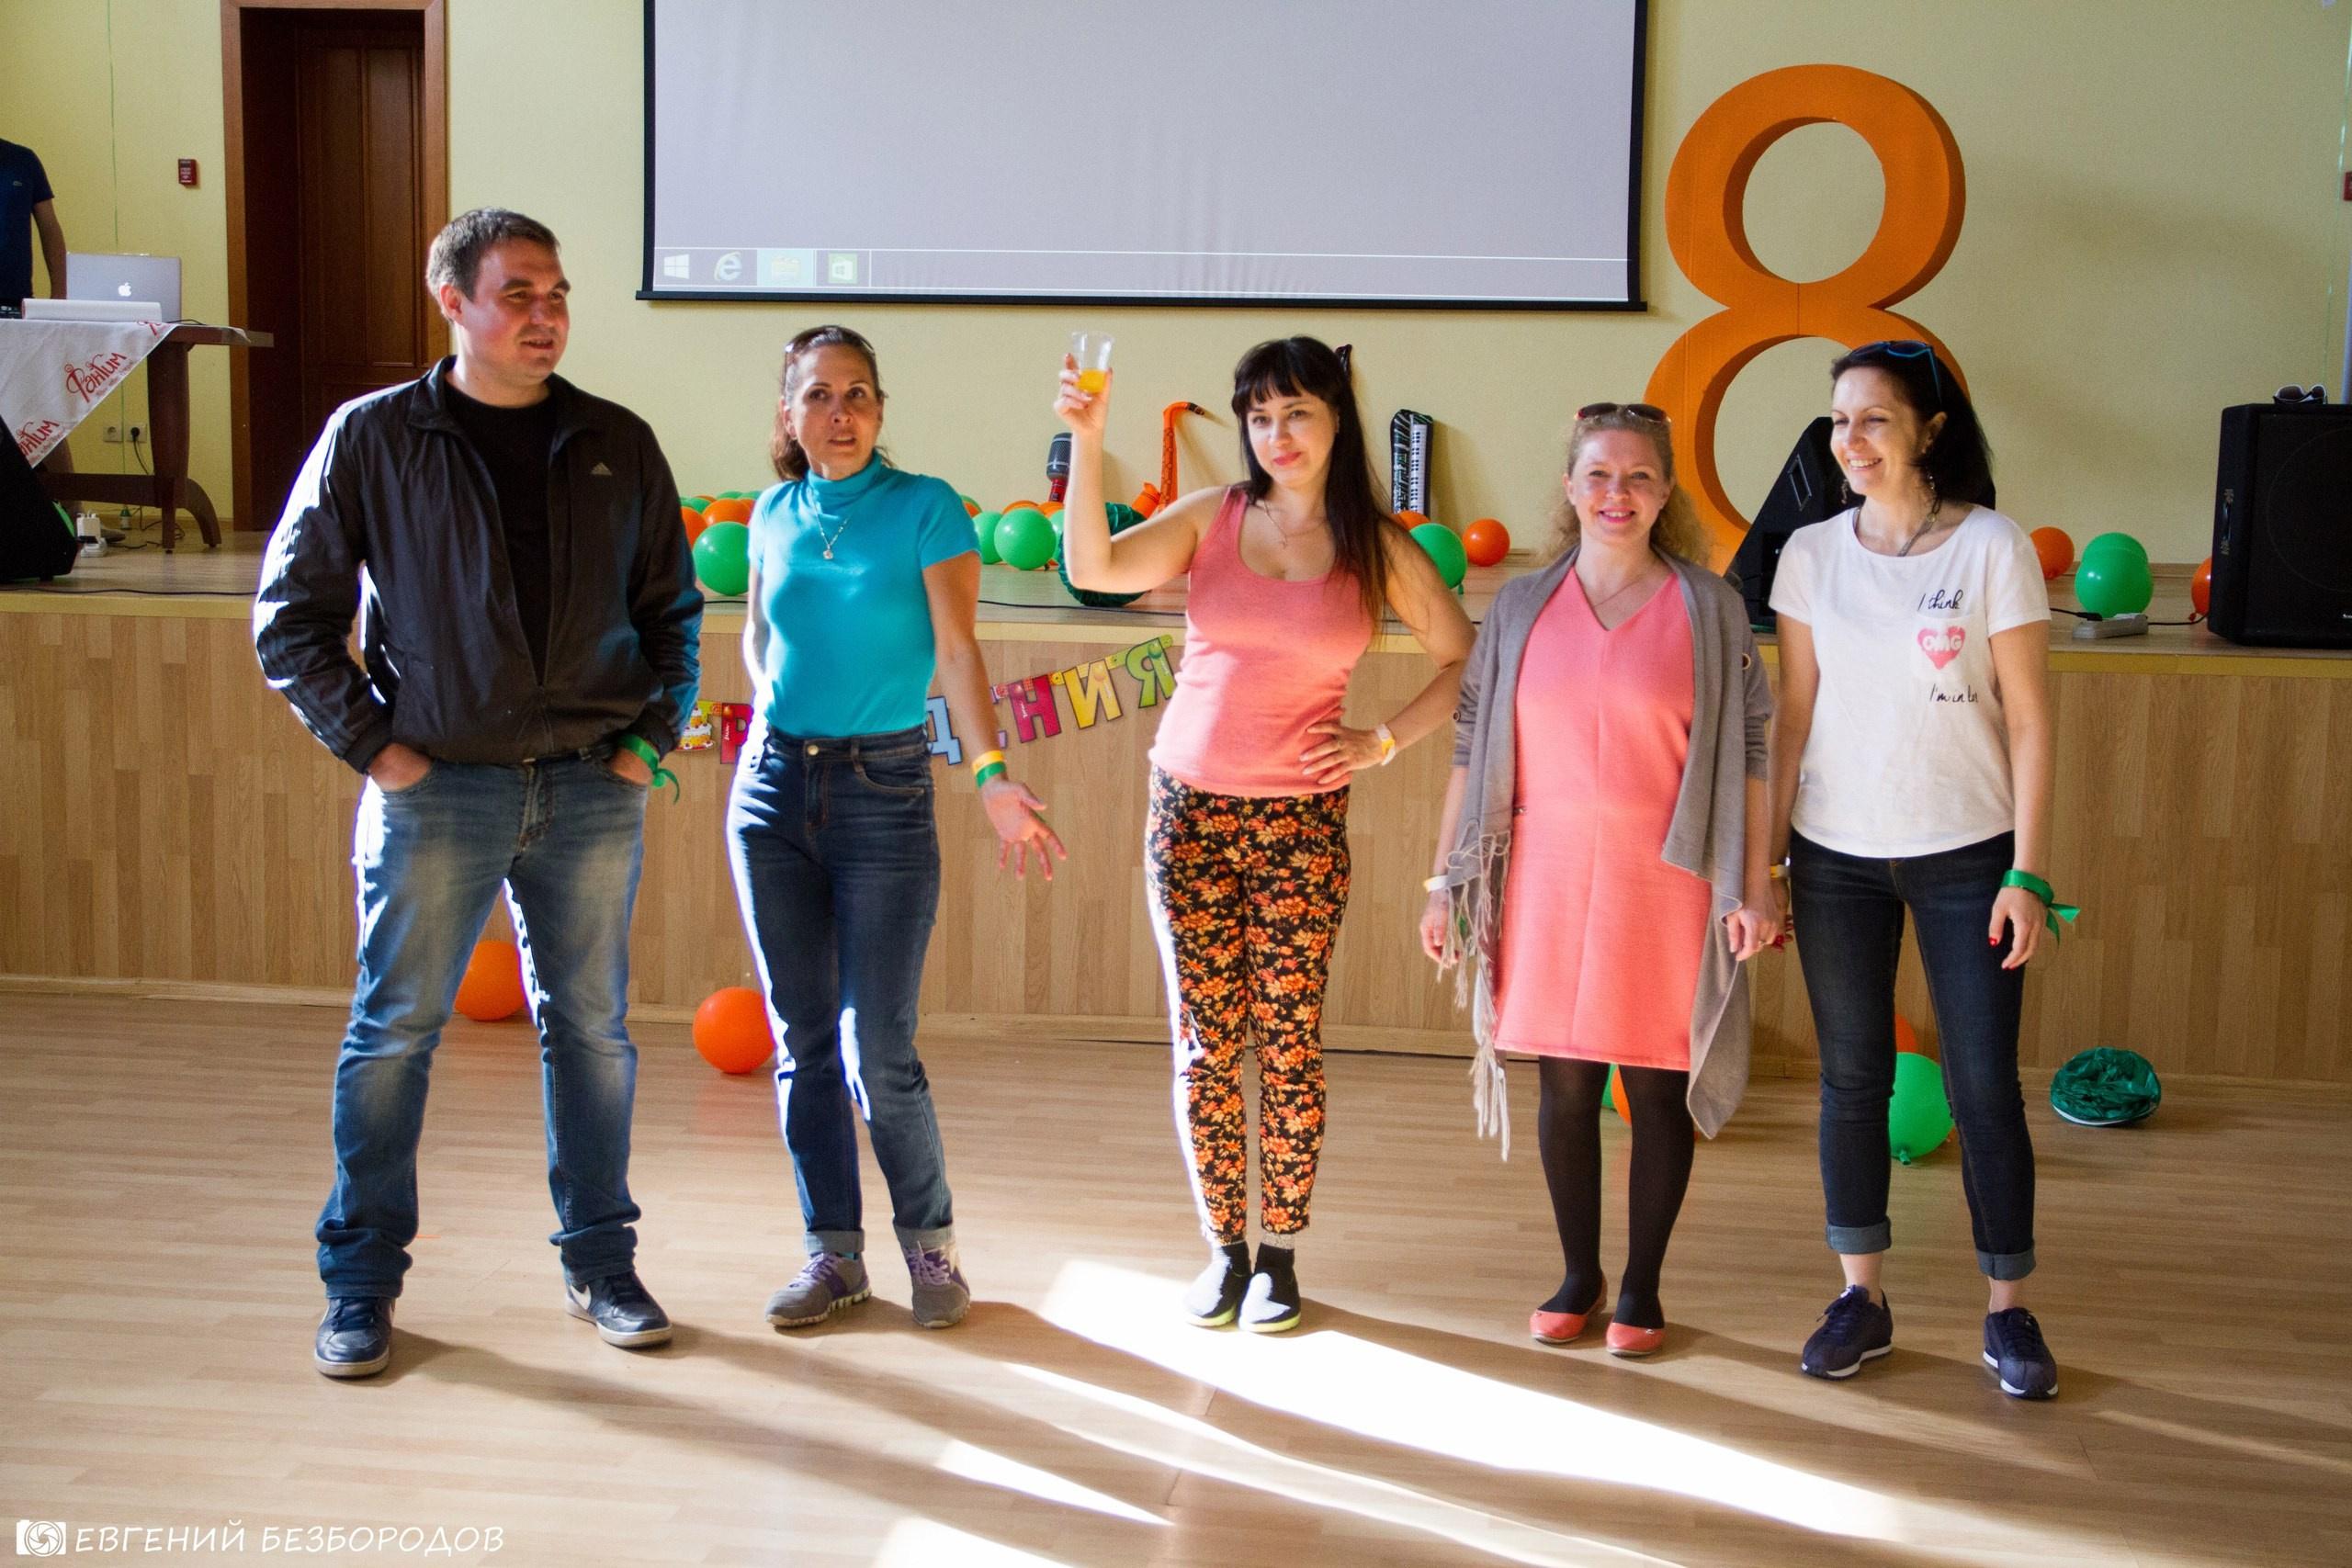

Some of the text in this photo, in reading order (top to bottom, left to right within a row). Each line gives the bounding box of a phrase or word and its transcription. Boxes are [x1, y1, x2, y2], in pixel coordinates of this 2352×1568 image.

[1644, 63, 1972, 581] 8
[1928, 589, 1963, 610] think
[1922, 633, 1964, 651] OMG
